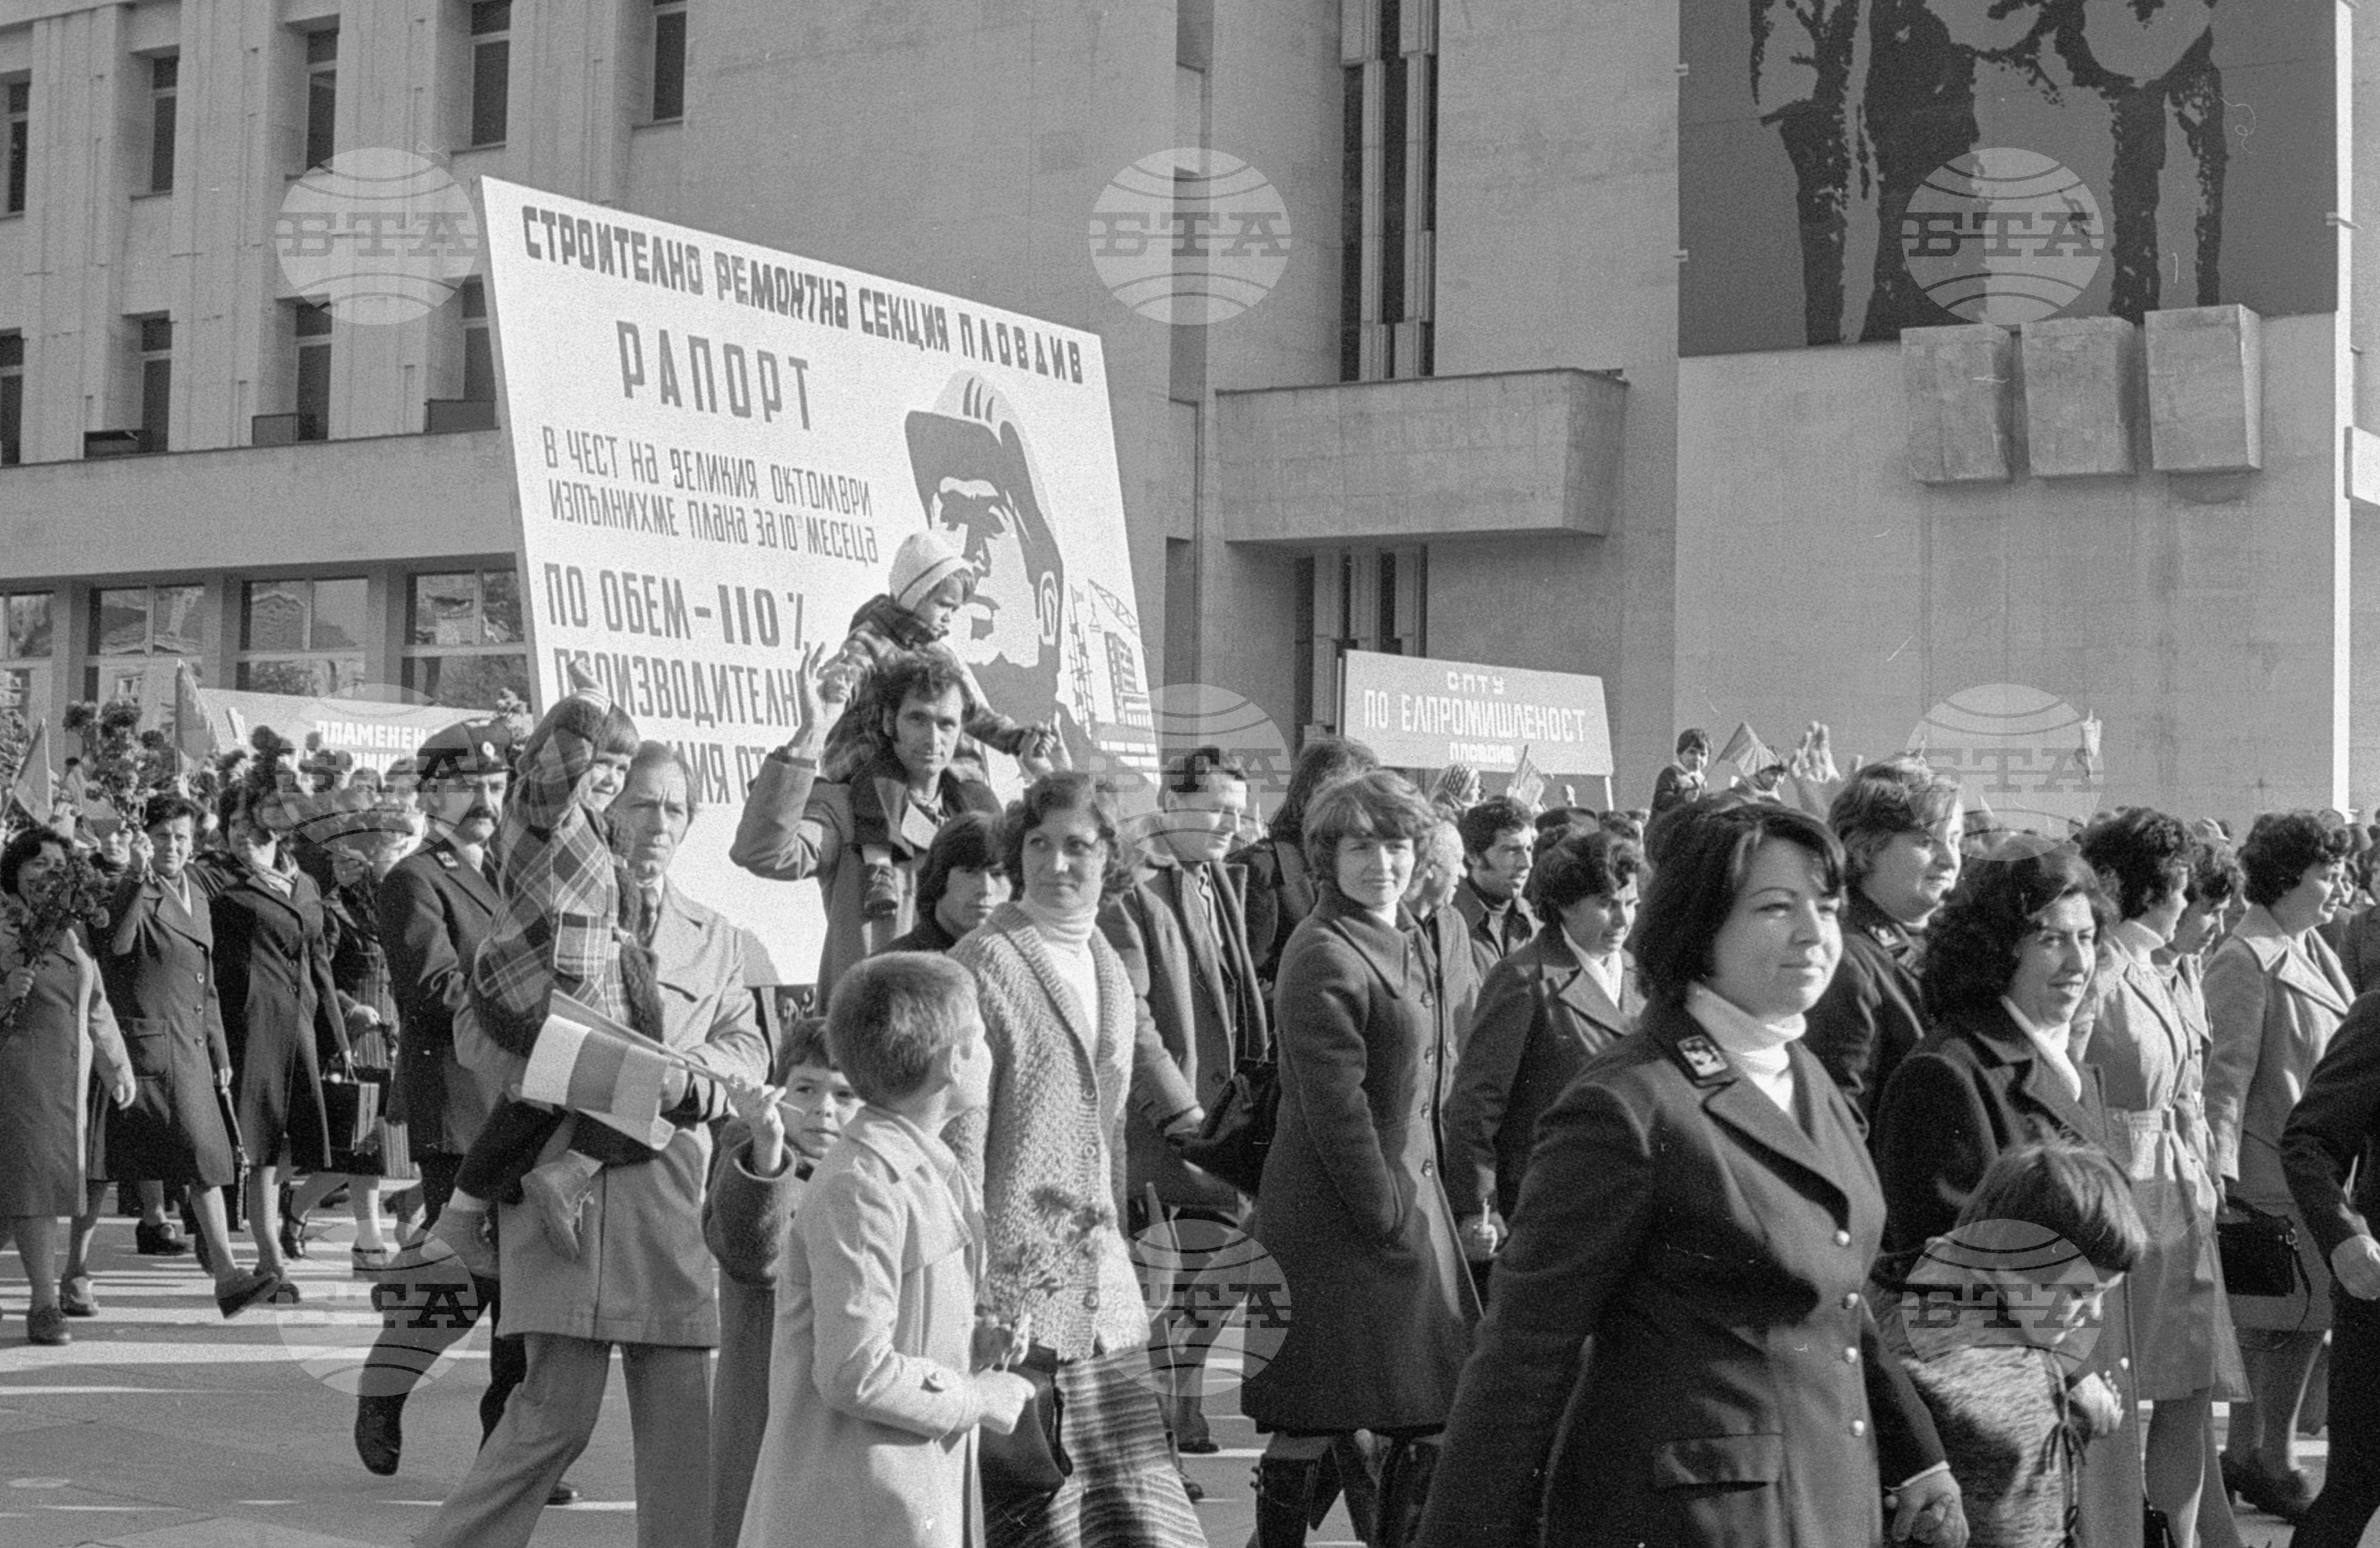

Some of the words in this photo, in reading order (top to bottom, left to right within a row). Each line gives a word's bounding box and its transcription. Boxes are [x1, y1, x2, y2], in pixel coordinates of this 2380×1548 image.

[522, 205, 704, 296] СТРОИТЕЛНО
[859, 287, 950, 353] СЕКЦИЯ
[958, 312, 1083, 384] ПЛОВДИВ
[616, 319, 810, 431] РАПОРТ
[542, 425, 559, 468] В
[566, 429, 618, 479] ЧЕСТ
[669, 448, 759, 499] ВЕЛИКИЯ
[770, 464, 873, 518] ОКТОМВРИ
[548, 478, 679, 537] ИЗПЪЛНИХМЕ
[544, 562, 588, 628] ПО
[553, 647, 801, 728] ПОИЗВОДИТЕЛН
[1364, 689, 1388, 729] ПО
[1401, 693, 1586, 743] ЕЛПРОМИШЛЕНОСТ
[1446, 670, 1504, 695] СПТУ
